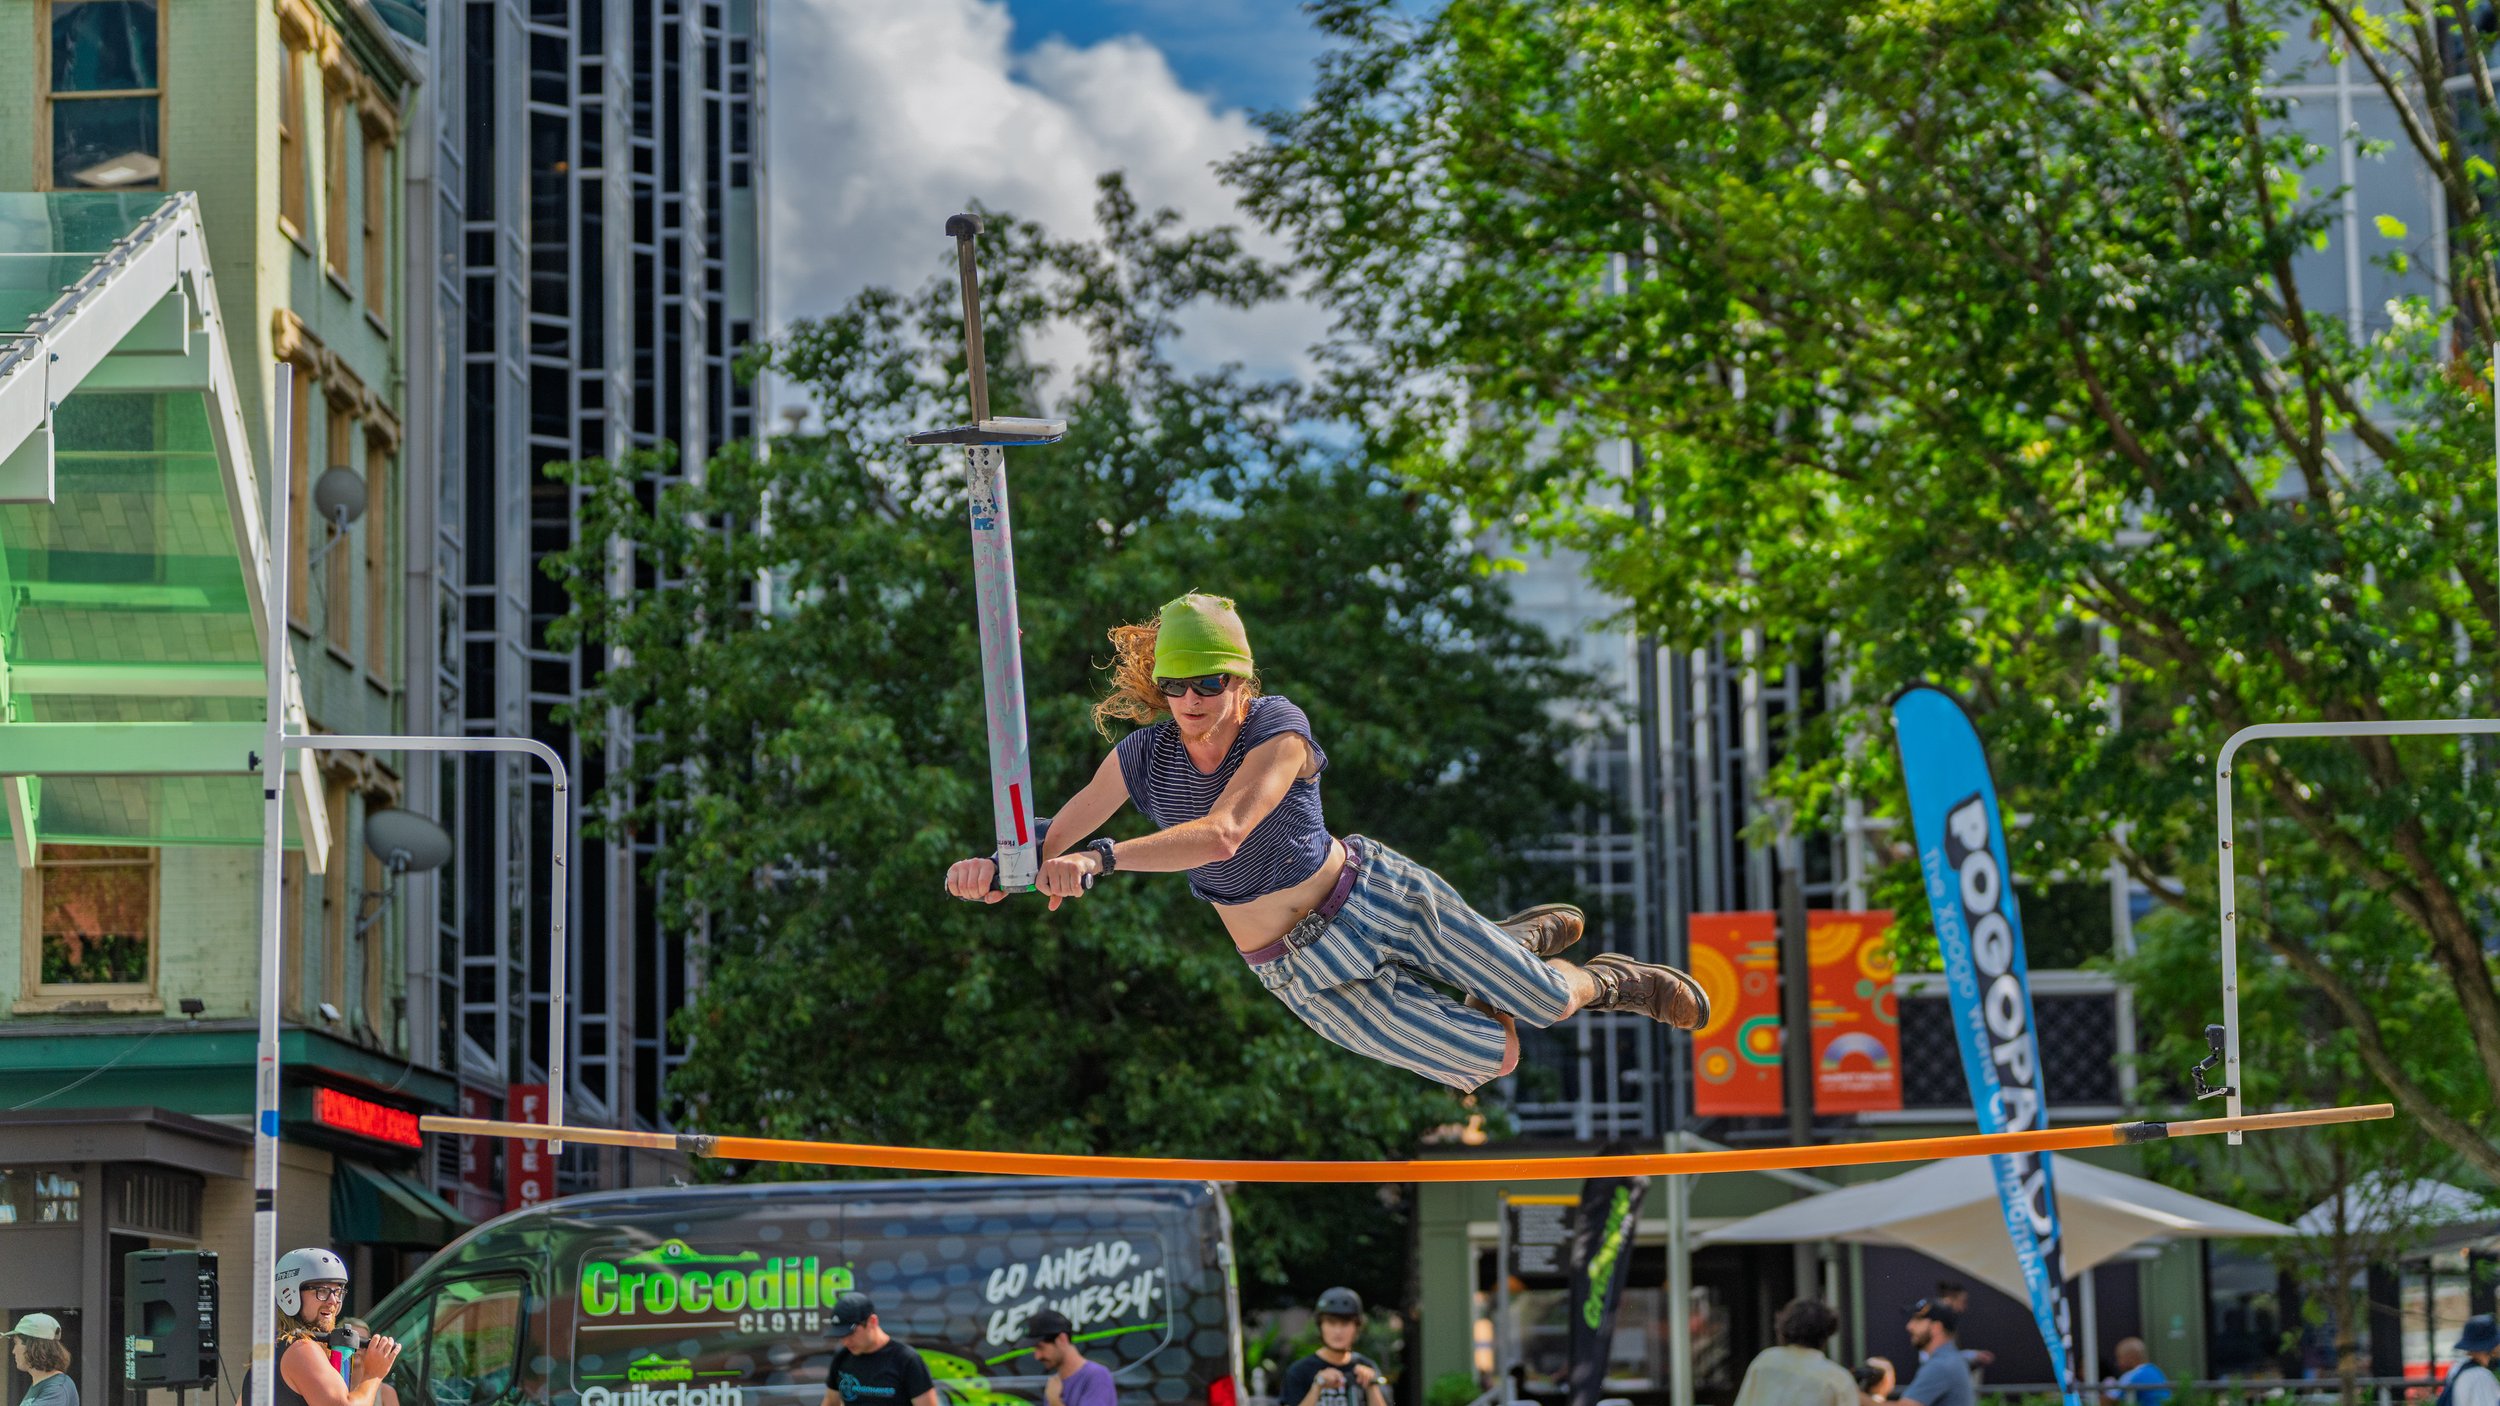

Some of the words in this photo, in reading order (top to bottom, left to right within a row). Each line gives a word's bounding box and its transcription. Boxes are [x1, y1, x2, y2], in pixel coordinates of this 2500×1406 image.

[1937, 902, 1976, 998] Xpogo
[581, 1255, 854, 1317] Crocodile
[986, 1263, 1028, 1304] GO
[1033, 1240, 1140, 1290] AHEAD.
[739, 1312, 820, 1334] CLOTH
[581, 1381, 743, 1406] Quikcloth
